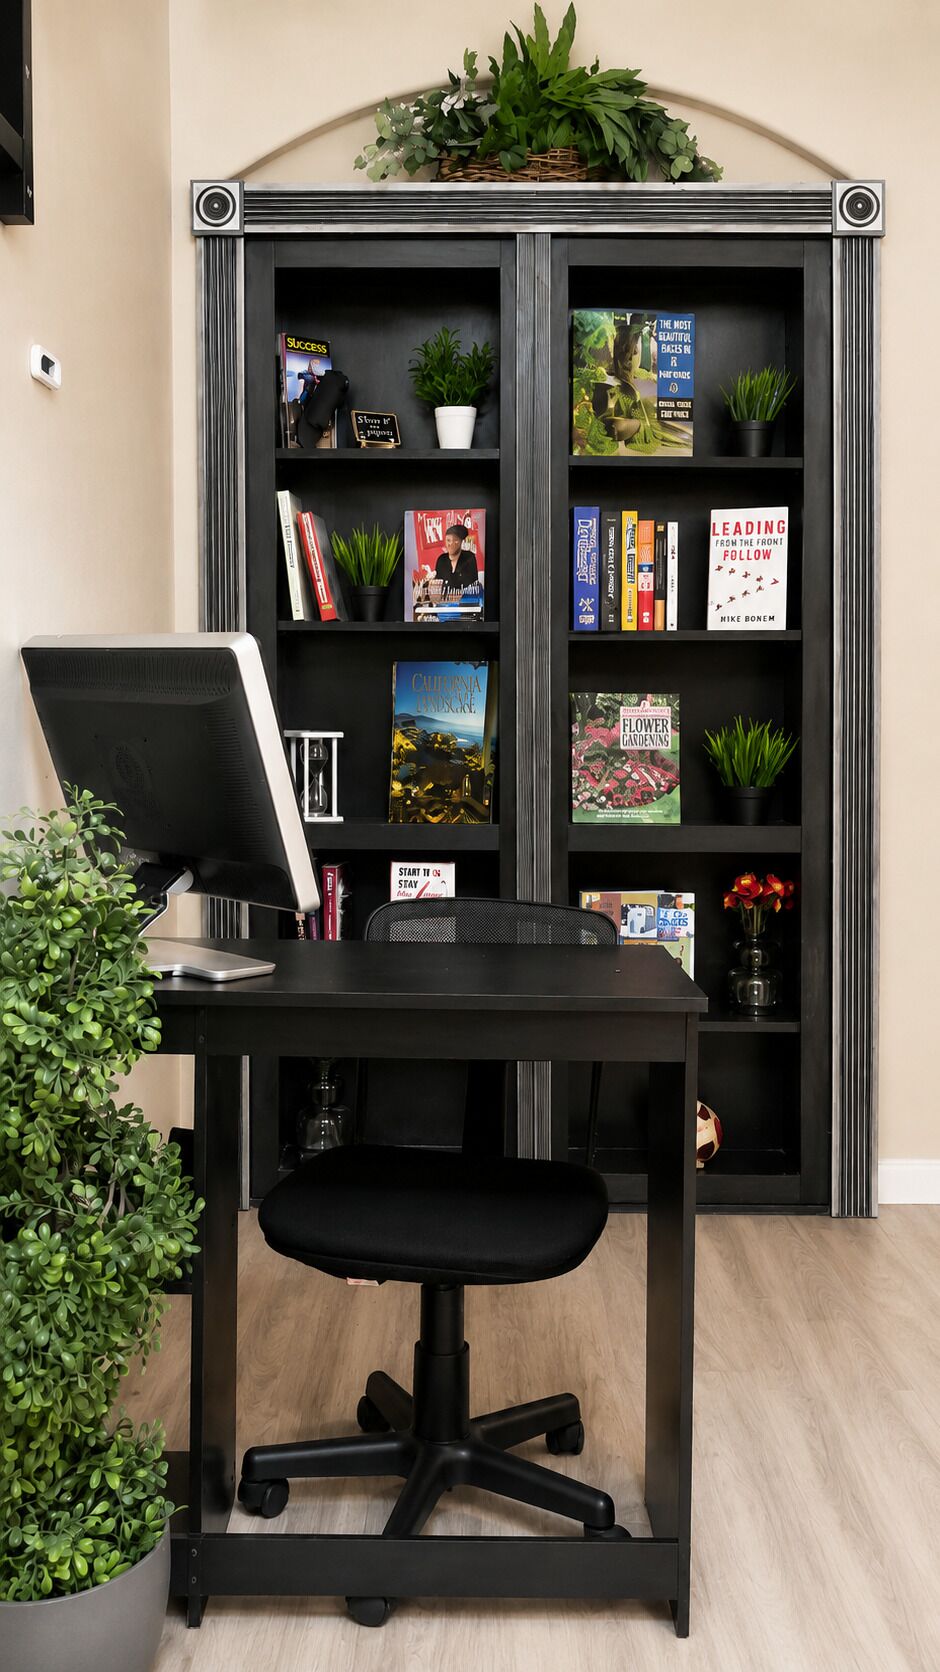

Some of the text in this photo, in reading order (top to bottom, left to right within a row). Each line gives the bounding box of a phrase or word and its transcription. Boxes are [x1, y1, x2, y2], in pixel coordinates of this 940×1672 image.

[287, 337, 327, 353] SUCCESS
[711, 520, 785, 536] LEADING
[715, 537, 783, 547] FROM THE FRONT
[723, 549, 772, 561] FOLLOW
[622, 718, 669, 733] FLOWER
[399, 867, 420, 877] START
[398, 879, 418, 888] STAY
